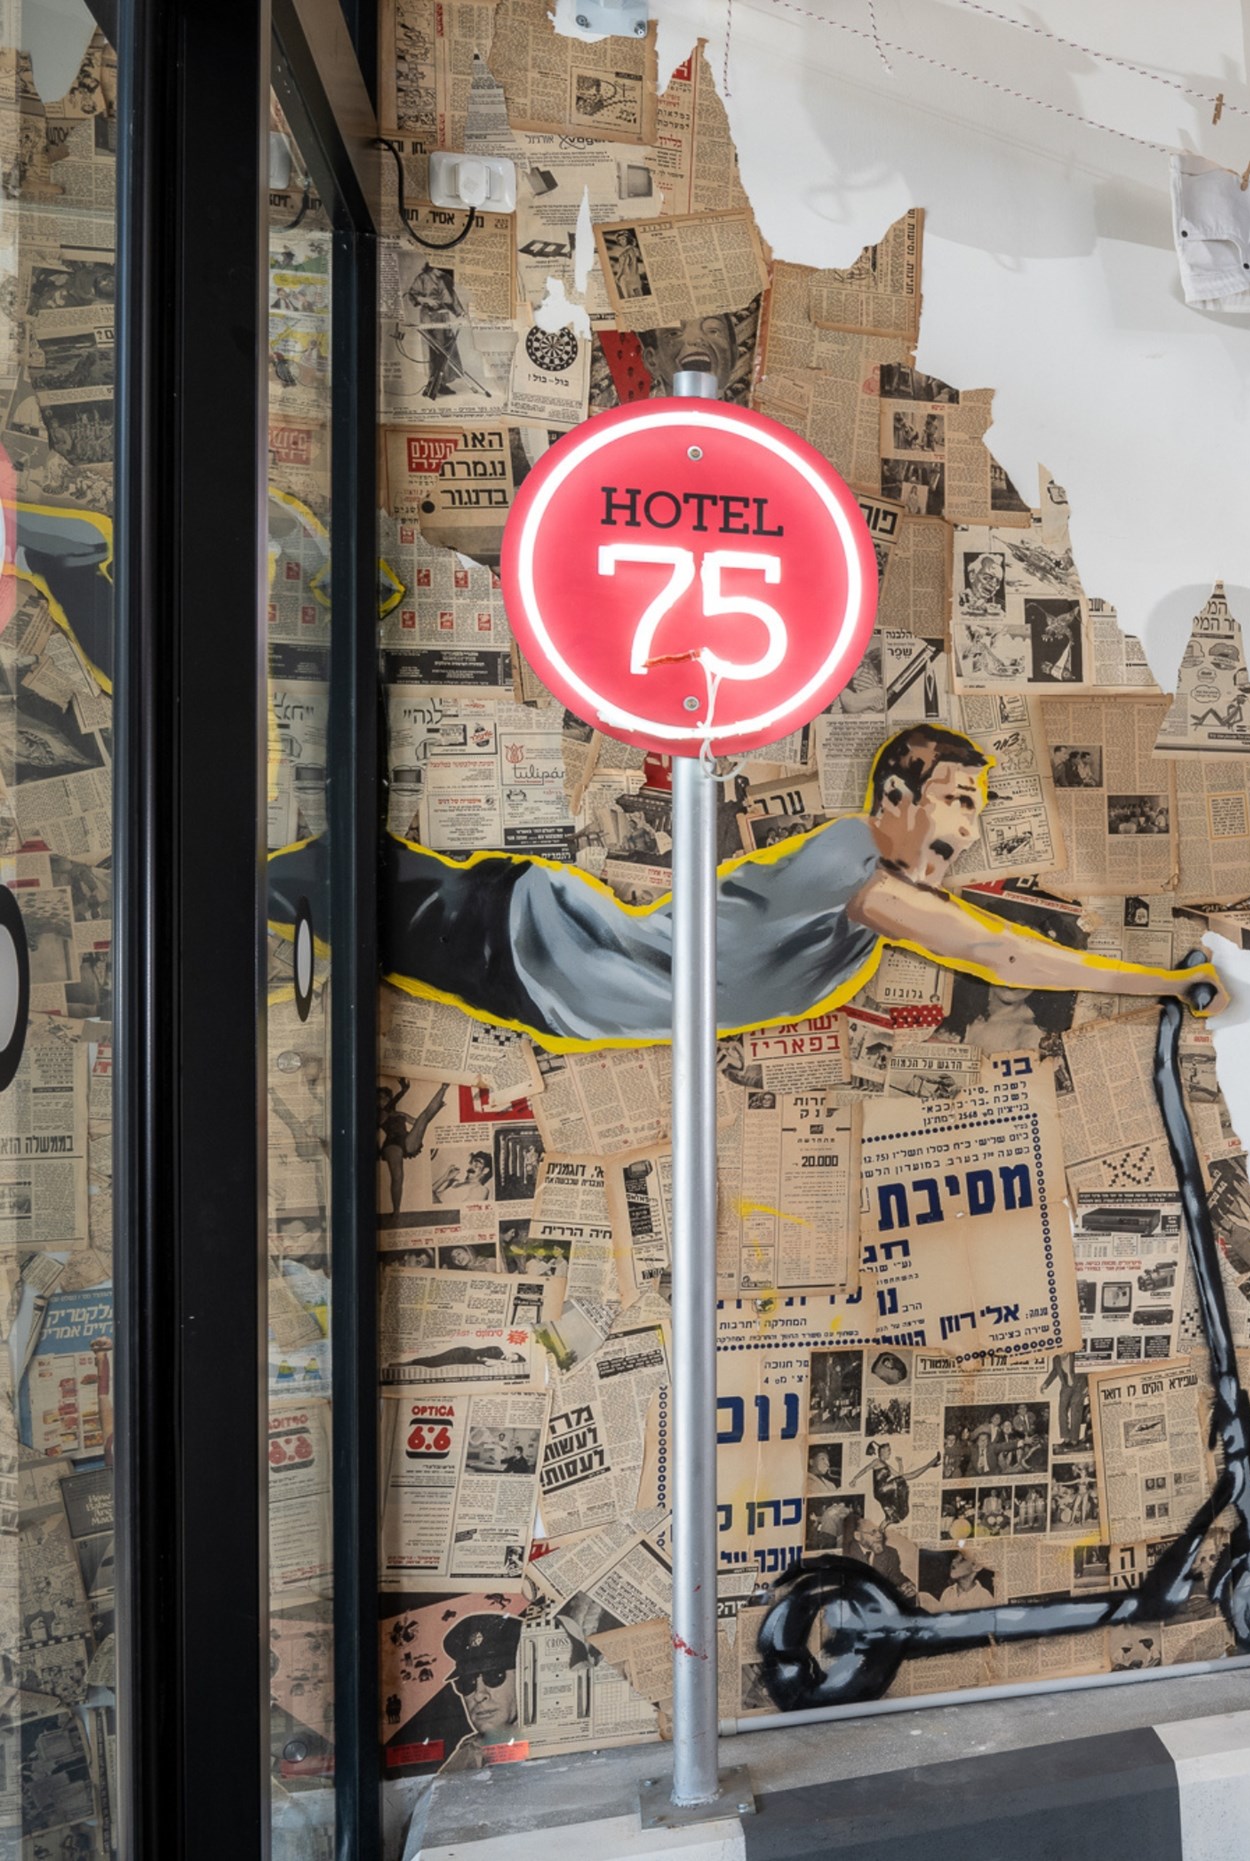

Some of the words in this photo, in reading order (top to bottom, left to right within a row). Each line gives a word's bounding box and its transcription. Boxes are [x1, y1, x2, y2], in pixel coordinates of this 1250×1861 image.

[601, 486, 784, 537] HOTEL
[597, 543, 788, 681] 75
[750, 1035, 840, 1058] בפאריז
[992, 1057, 1033, 1077] בני
[878, 1163, 1033, 1232] מסיבת
[541, 1225, 583, 1237] הררית
[979, 1304, 1020, 1325] אלי
[939, 1311, 977, 1340] רוזן
[989, 1330, 1021, 1341] בציבור
[1024, 1325, 1050, 1336] שירה
[764, 1360, 790, 1369] חנוכה
[412, 1405, 455, 1417] OPTICA
